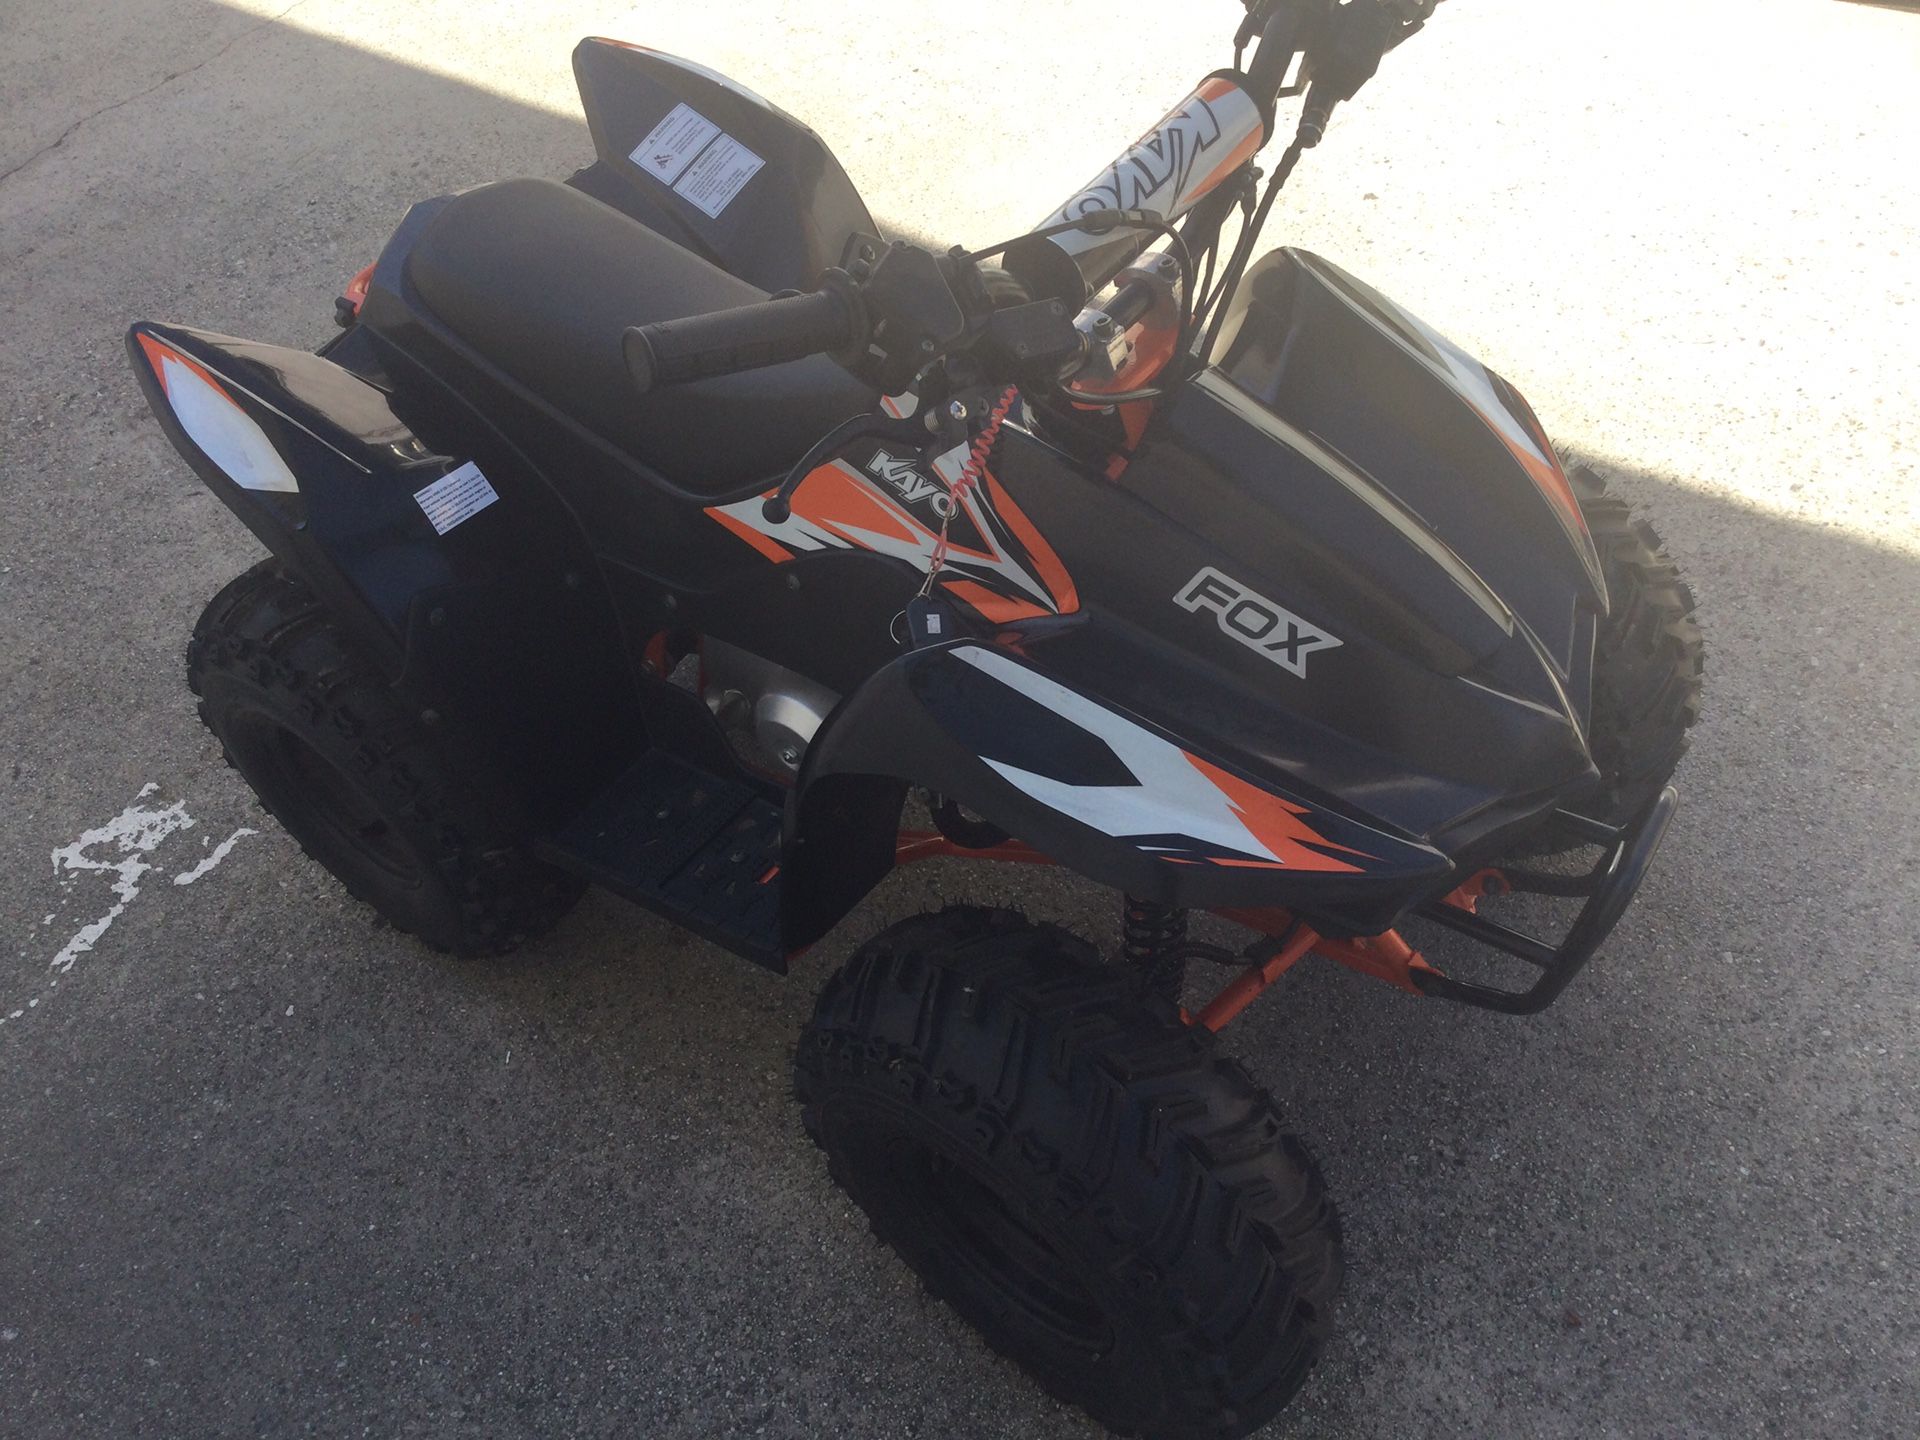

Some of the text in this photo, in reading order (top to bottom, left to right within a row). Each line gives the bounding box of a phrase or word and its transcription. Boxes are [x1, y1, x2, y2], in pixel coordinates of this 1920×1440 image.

[1062, 96, 1221, 236] KAYO
[867, 450, 959, 519] KAYO
[1185, 575, 1322, 666] FOX
